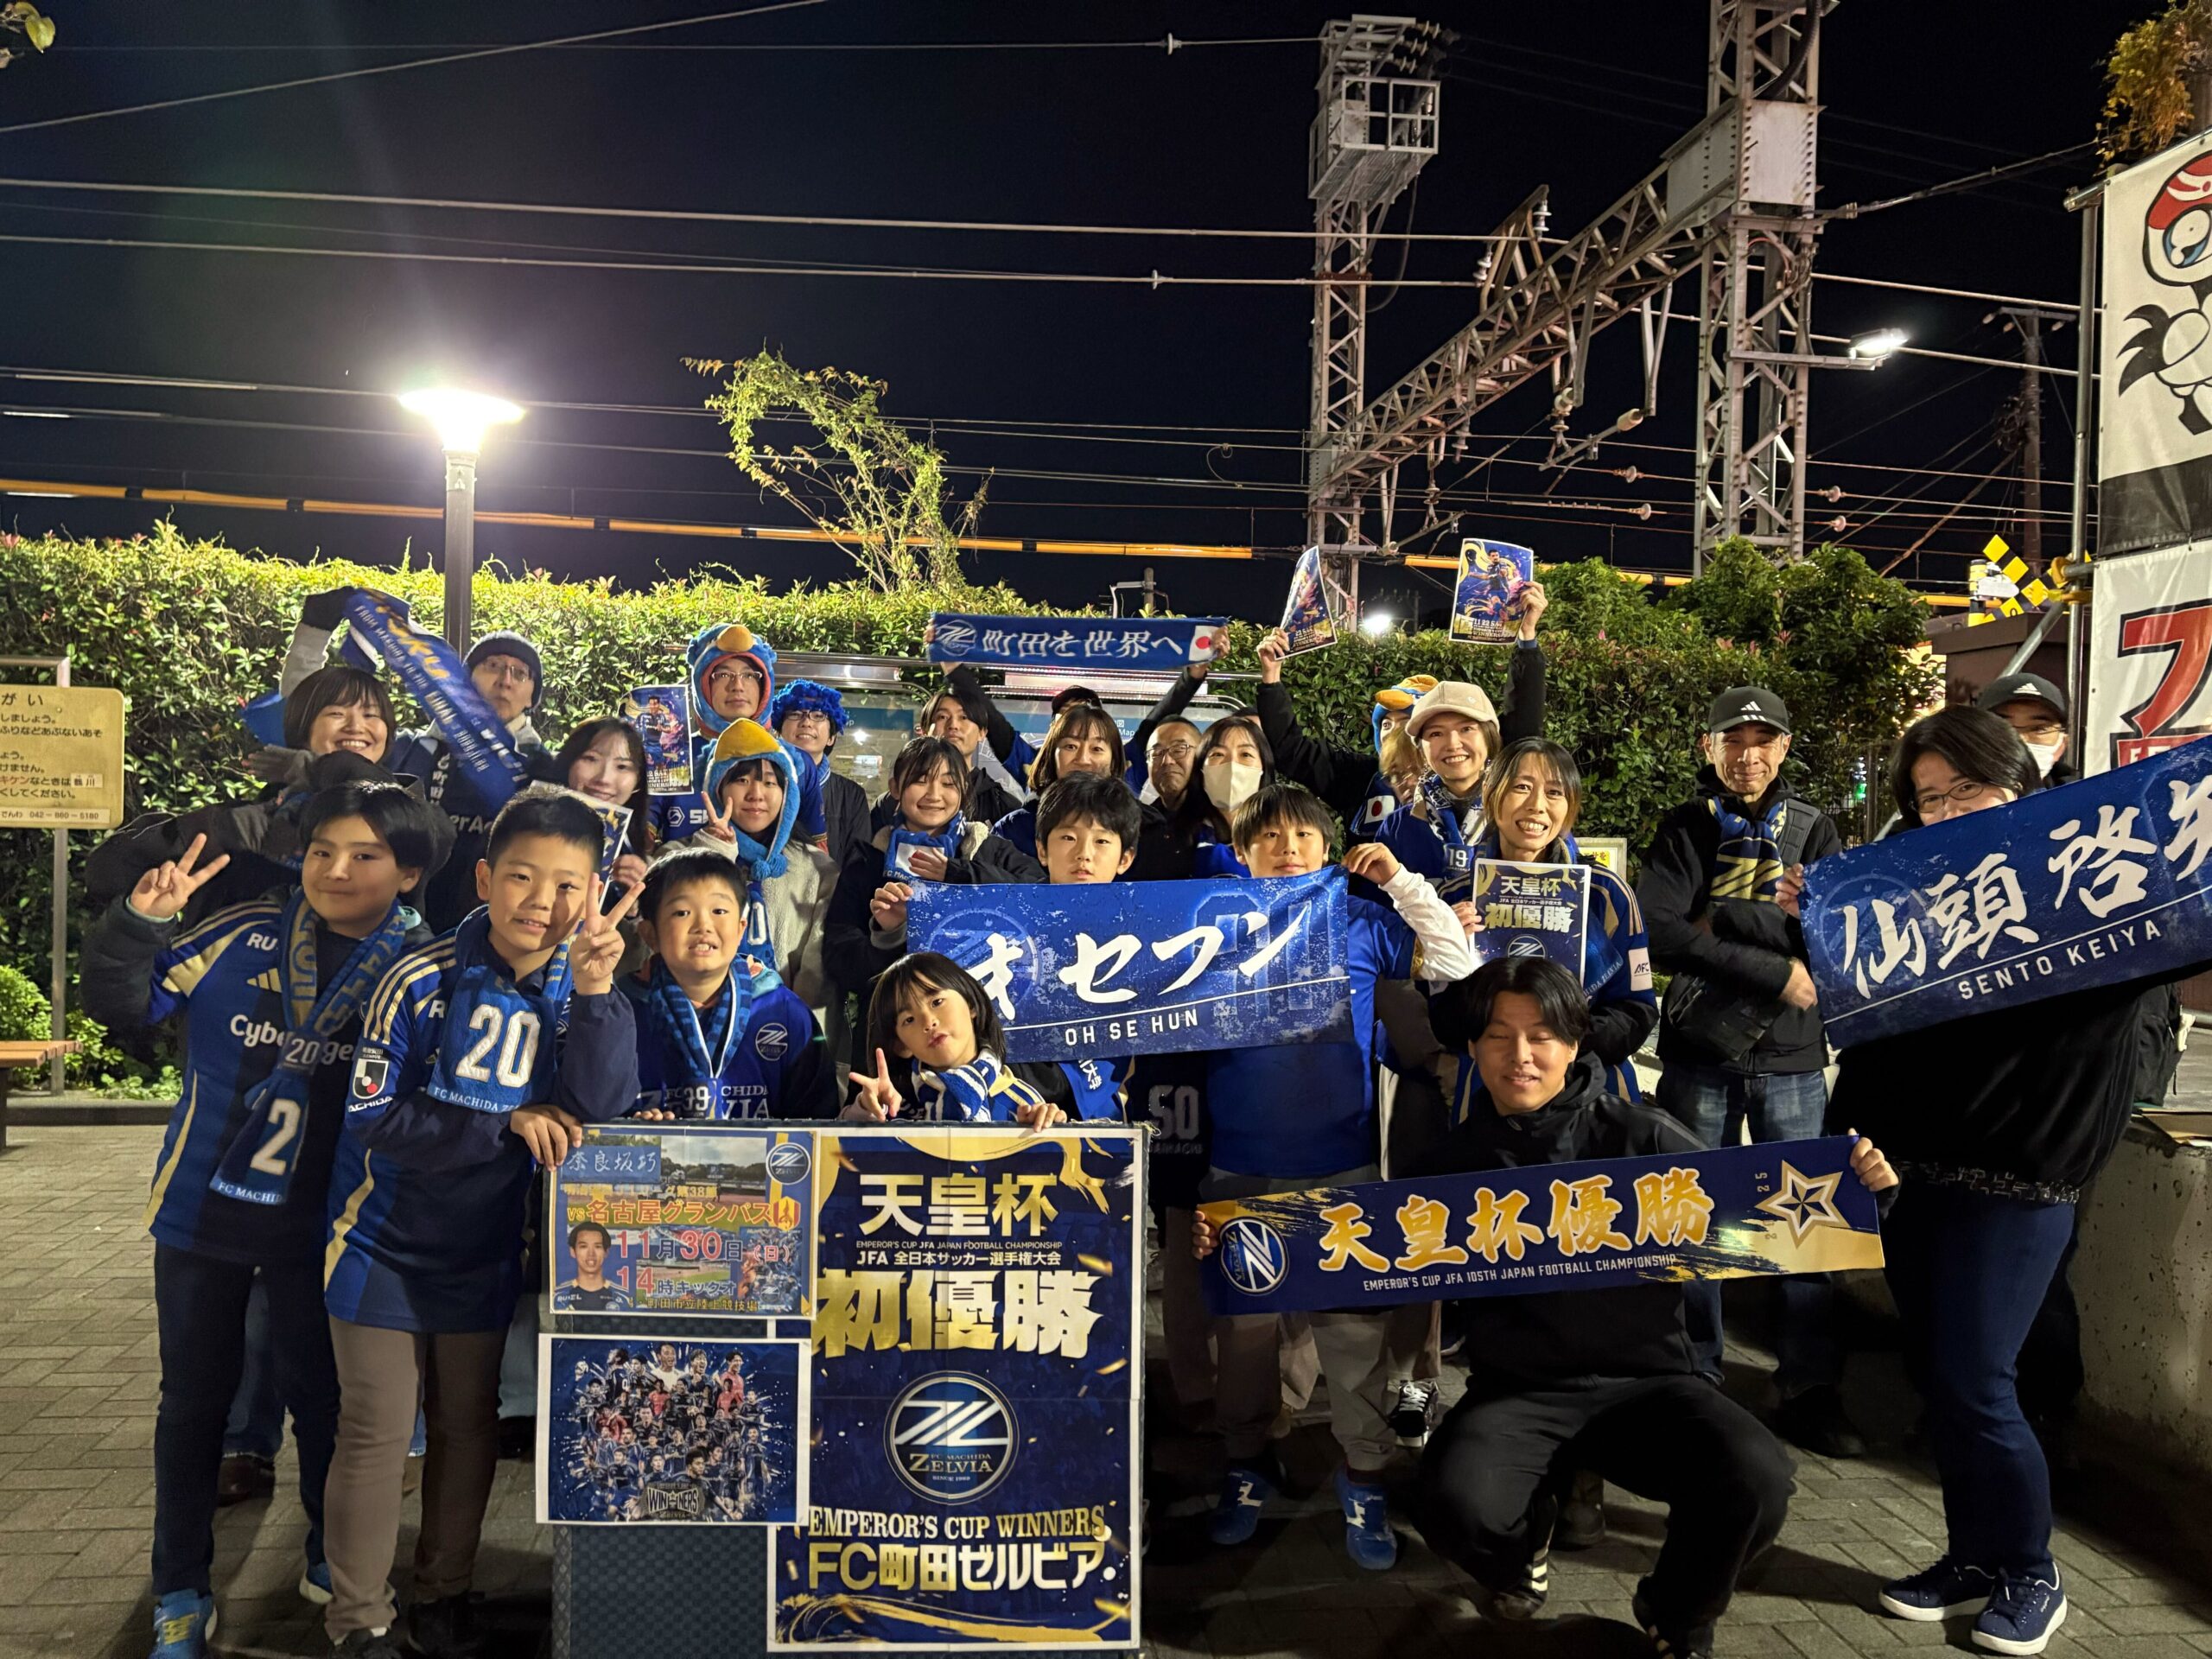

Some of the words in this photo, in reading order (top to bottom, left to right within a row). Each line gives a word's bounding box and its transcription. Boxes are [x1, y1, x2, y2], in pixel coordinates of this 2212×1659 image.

[982, 629, 1184, 658] 町田を世界へ
[1, 715, 56, 724] しましょう。
[1119, 728, 1135, 738] Map
[1449, 849, 1469, 868] 19
[1500, 875, 1561, 897] 天皇杯
[1484, 902, 1574, 933] 初優勝
[1634, 963, 1649, 975] AFC
[1958, 956, 2054, 1001] SENTO
[2068, 919, 2162, 966] KEIYA
[1065, 1025, 1096, 1046] OH
[1109, 1020, 1141, 1040] SE
[1151, 1008, 1198, 1033] HUN
[284, 1038, 320, 1065] 20
[455, 1003, 542, 1089] 20
[435, 1087, 448, 1099] FC
[449, 1091, 499, 1110] MACHIDA
[1148, 1084, 1200, 1140] 50
[218, 1181, 233, 1194] FC
[587, 1198, 774, 1225] 名古屋グランパス
[859, 1173, 1059, 1236] 天皇杯
[1319, 1166, 1715, 1274] 天皇杯優勝
[856, 1251, 889, 1266] JFA
[894, 1251, 1061, 1266] 全日本サッカー選手権大会
[901, 1241, 918, 1249] CUP
[963, 1241, 1003, 1249] FOOTBALL
[1005, 1241, 1063, 1249] CHAMPIONSHIP
[1363, 1276, 1419, 1292] EMPEROR'S
[1421, 1274, 1441, 1287] CUP
[1445, 1273, 1464, 1285] JFA
[1501, 1266, 1535, 1279] JAPAN
[1539, 1262, 1592, 1275] FOOTBALL
[1596, 1254, 1676, 1272] CHAMPIONSHIP
[811, 1268, 1104, 1359] 初優勝
[909, 1452, 994, 1473] ZELVIA
[808, 1505, 938, 1540] EMPEROR'S
[944, 1516, 990, 1541] CUP
[995, 1504, 1106, 1539] WINNERS
[809, 1541, 1106, 1592] FC町田ゼルビア
